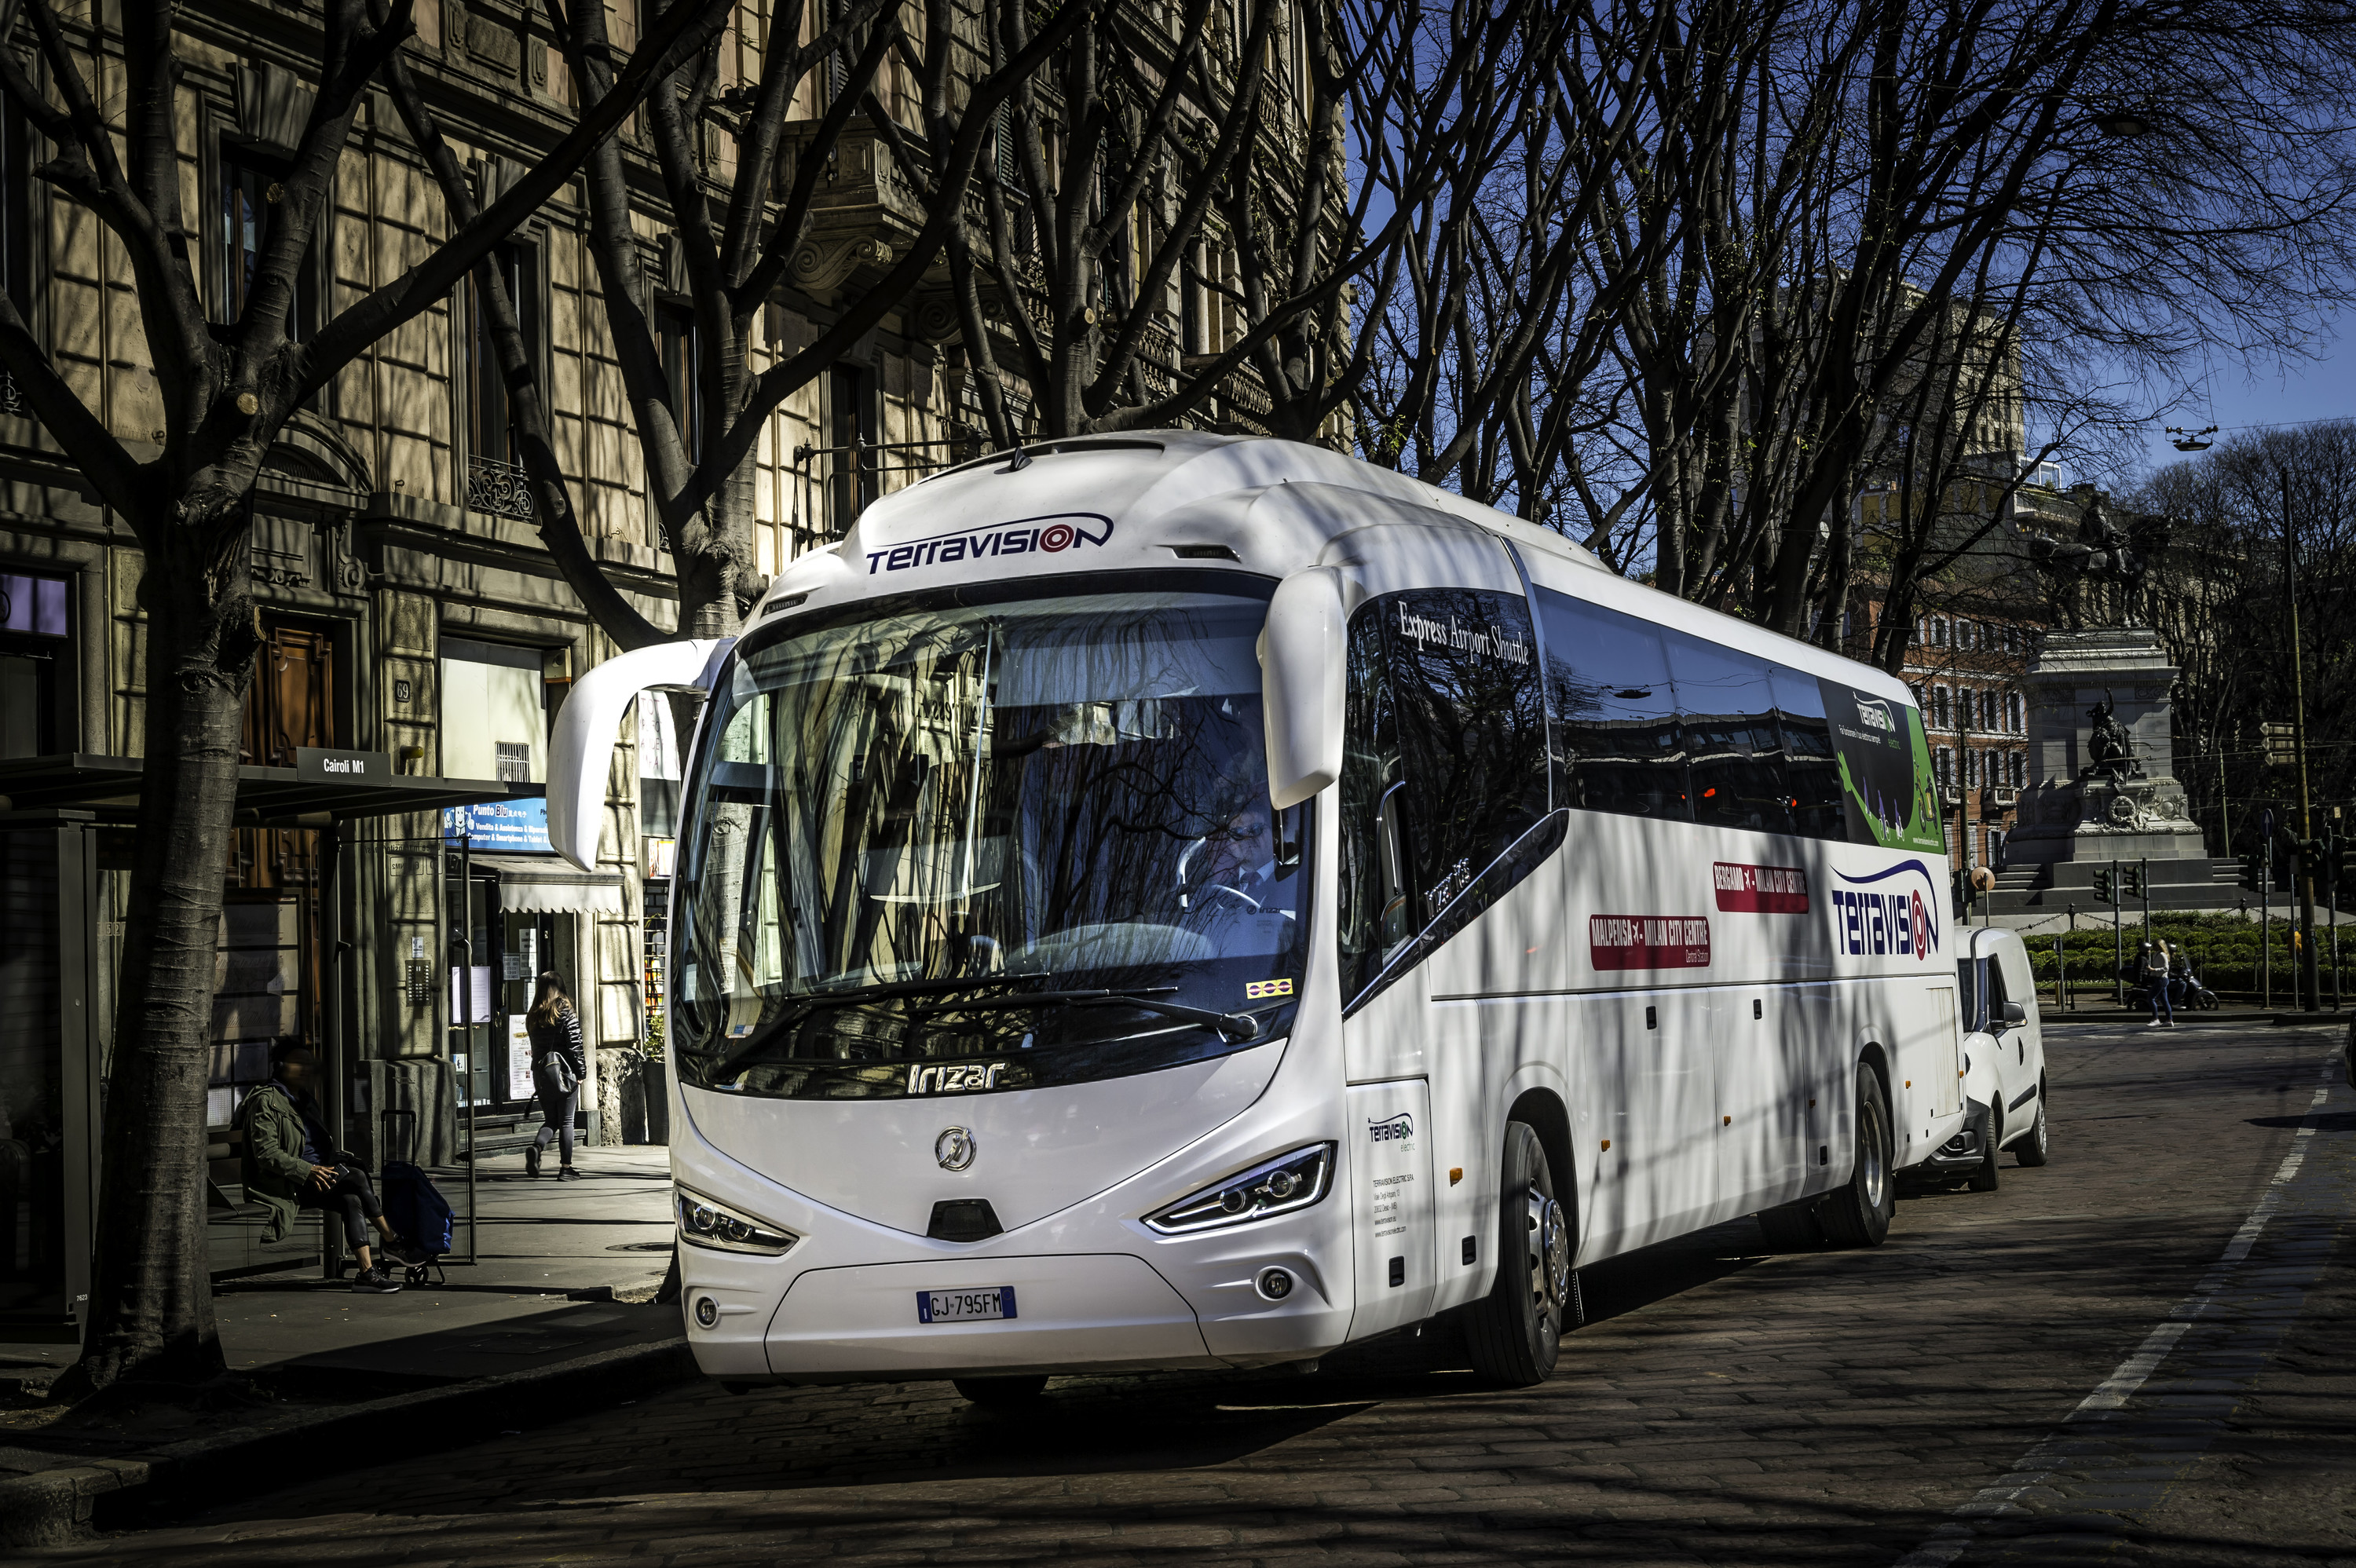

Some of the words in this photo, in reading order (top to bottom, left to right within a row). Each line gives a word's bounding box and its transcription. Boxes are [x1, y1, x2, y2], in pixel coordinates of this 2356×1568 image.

[1398, 601, 1447, 652] Express
[1450, 615, 1491, 664] Airport
[1491, 625, 1530, 666] Shuttle
[324, 758, 350, 773] Cairoli
[352, 759, 365, 774] M1
[473, 804, 495, 817] Punto
[496, 805, 508, 817] Blu
[476, 823, 495, 832] Vendita
[499, 824, 524, 833] Assistenza
[467, 833, 491, 842] Computer
[496, 834, 524, 843] Smartphone
[1714, 864, 1744, 891] BERGAMO
[1755, 868, 1775, 893] MILAN
[1773, 869, 1787, 894] CITY
[1786, 871, 1807, 894] CENTRE
[1591, 919, 1633, 947] MALPENSA
[1644, 919, 1668, 946] MILAN
[1668, 919, 1683, 947] CITY
[1684, 919, 1707, 946] CENTRE
[1685, 948, 1698, 963] Central
[1697, 948, 1709, 963] Station
[1400, 1140, 1416, 1153] electric
[1373, 1178, 1393, 1188] TERRAVISION
[1392, 1175, 1407, 1185] ELECTRIC
